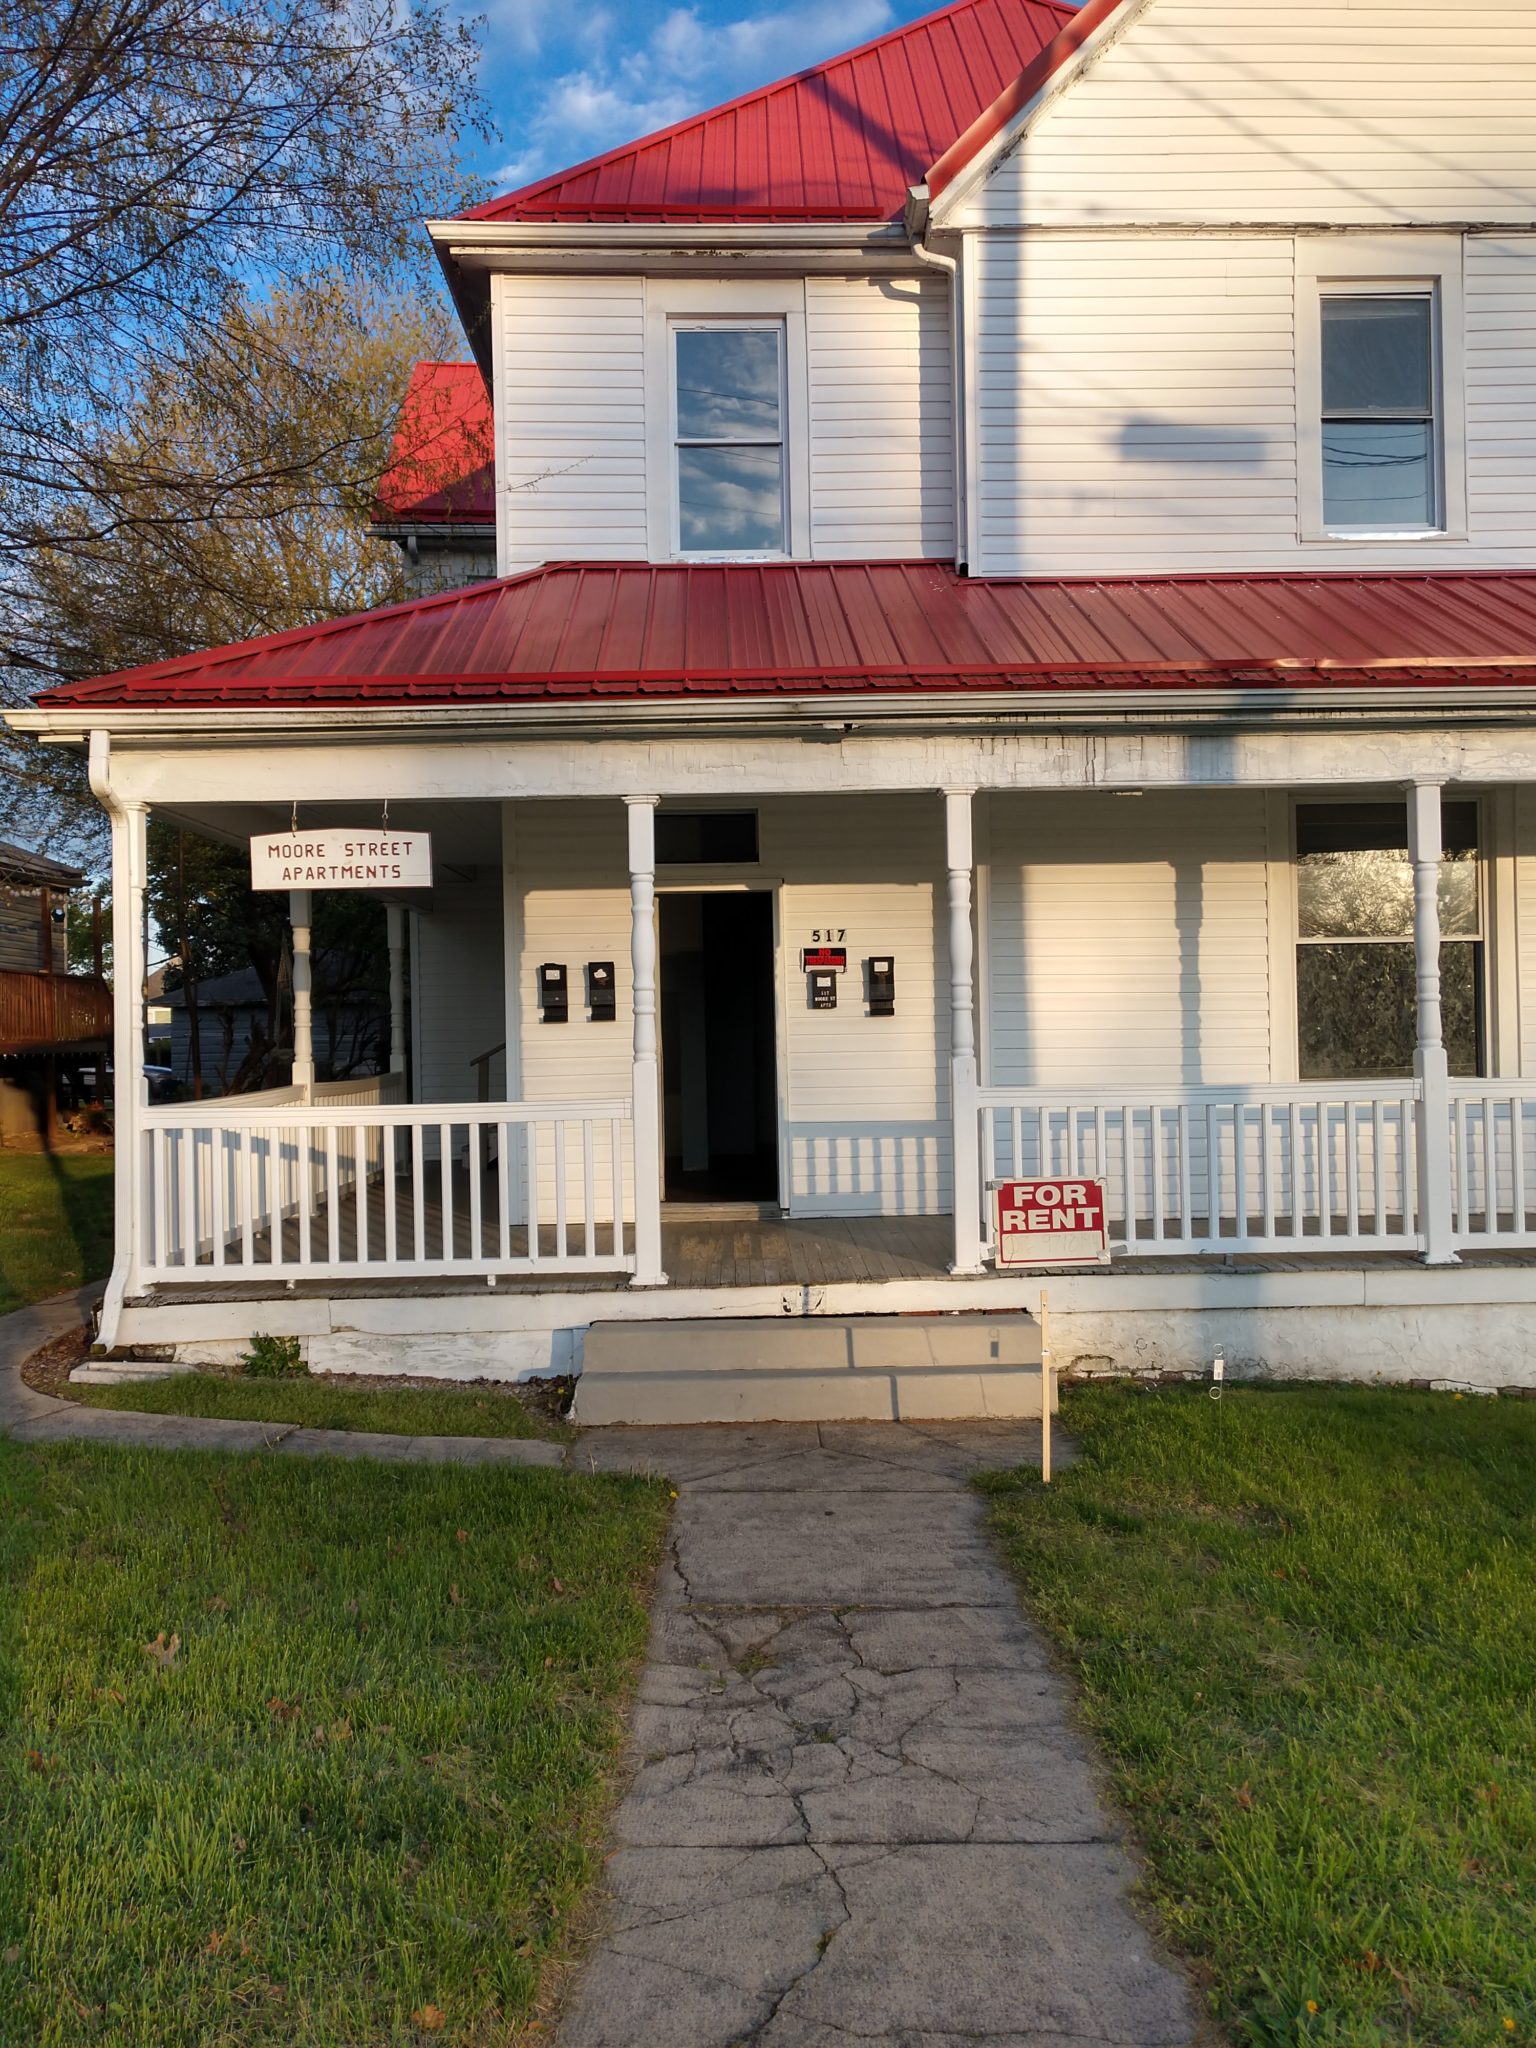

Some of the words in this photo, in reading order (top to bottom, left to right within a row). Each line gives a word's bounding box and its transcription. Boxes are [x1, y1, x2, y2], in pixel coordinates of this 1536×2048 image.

[268, 844, 325, 858] MOORE
[345, 842, 413, 857] STREET
[282, 865, 401, 880] APARTMENTS
[812, 929, 845, 942] 517
[819, 948, 832, 956] NO
[1013, 1184, 1087, 1207] FOR
[1002, 1207, 1099, 1231] RENT
